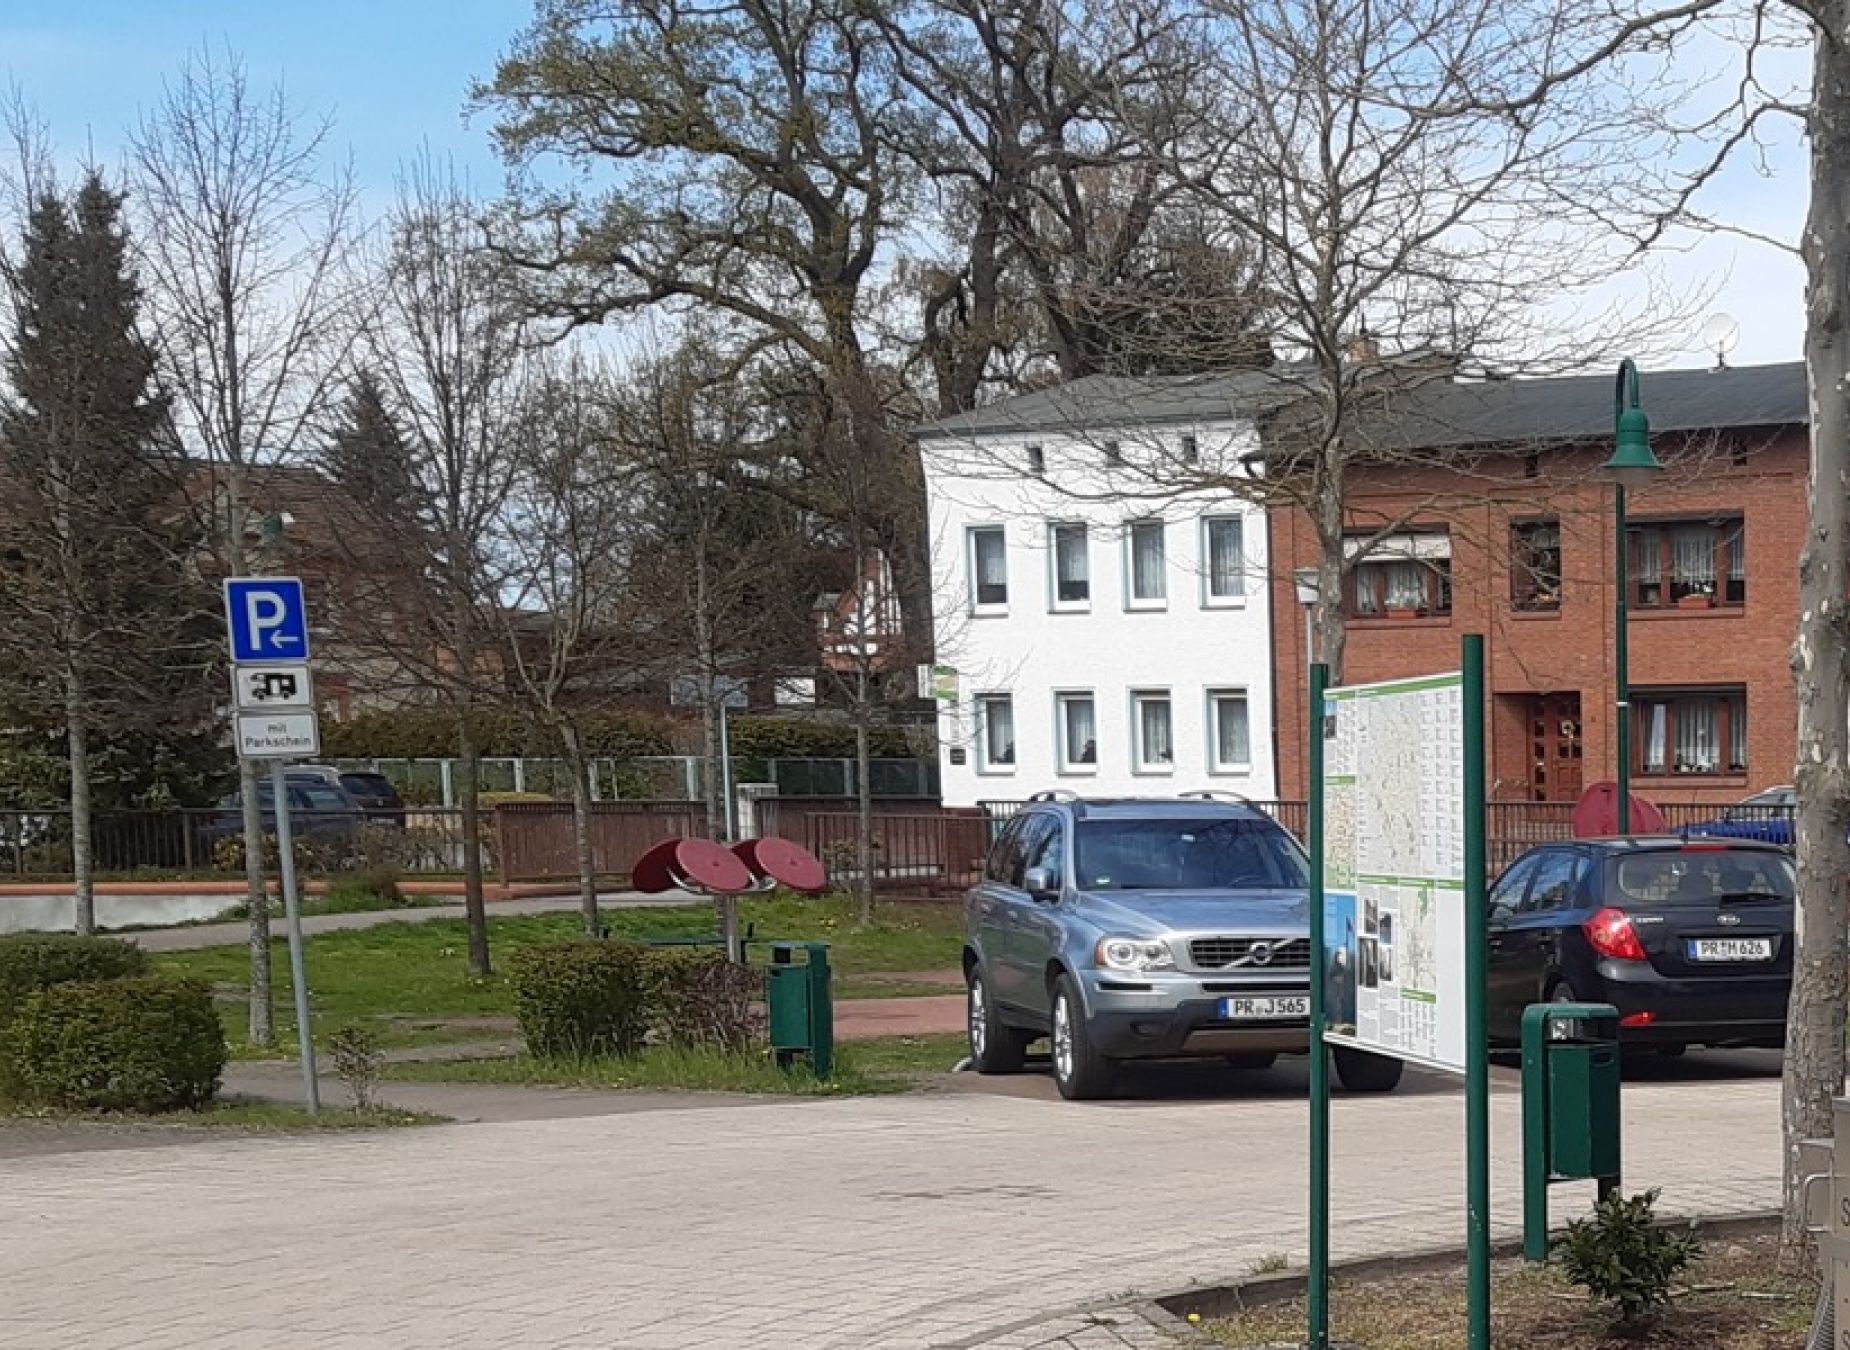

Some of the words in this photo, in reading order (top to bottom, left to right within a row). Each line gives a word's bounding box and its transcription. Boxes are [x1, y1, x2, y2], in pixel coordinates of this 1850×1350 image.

[245, 591, 287, 651] P
[267, 722, 287, 734] mit
[245, 735, 312, 749] Parkschein
